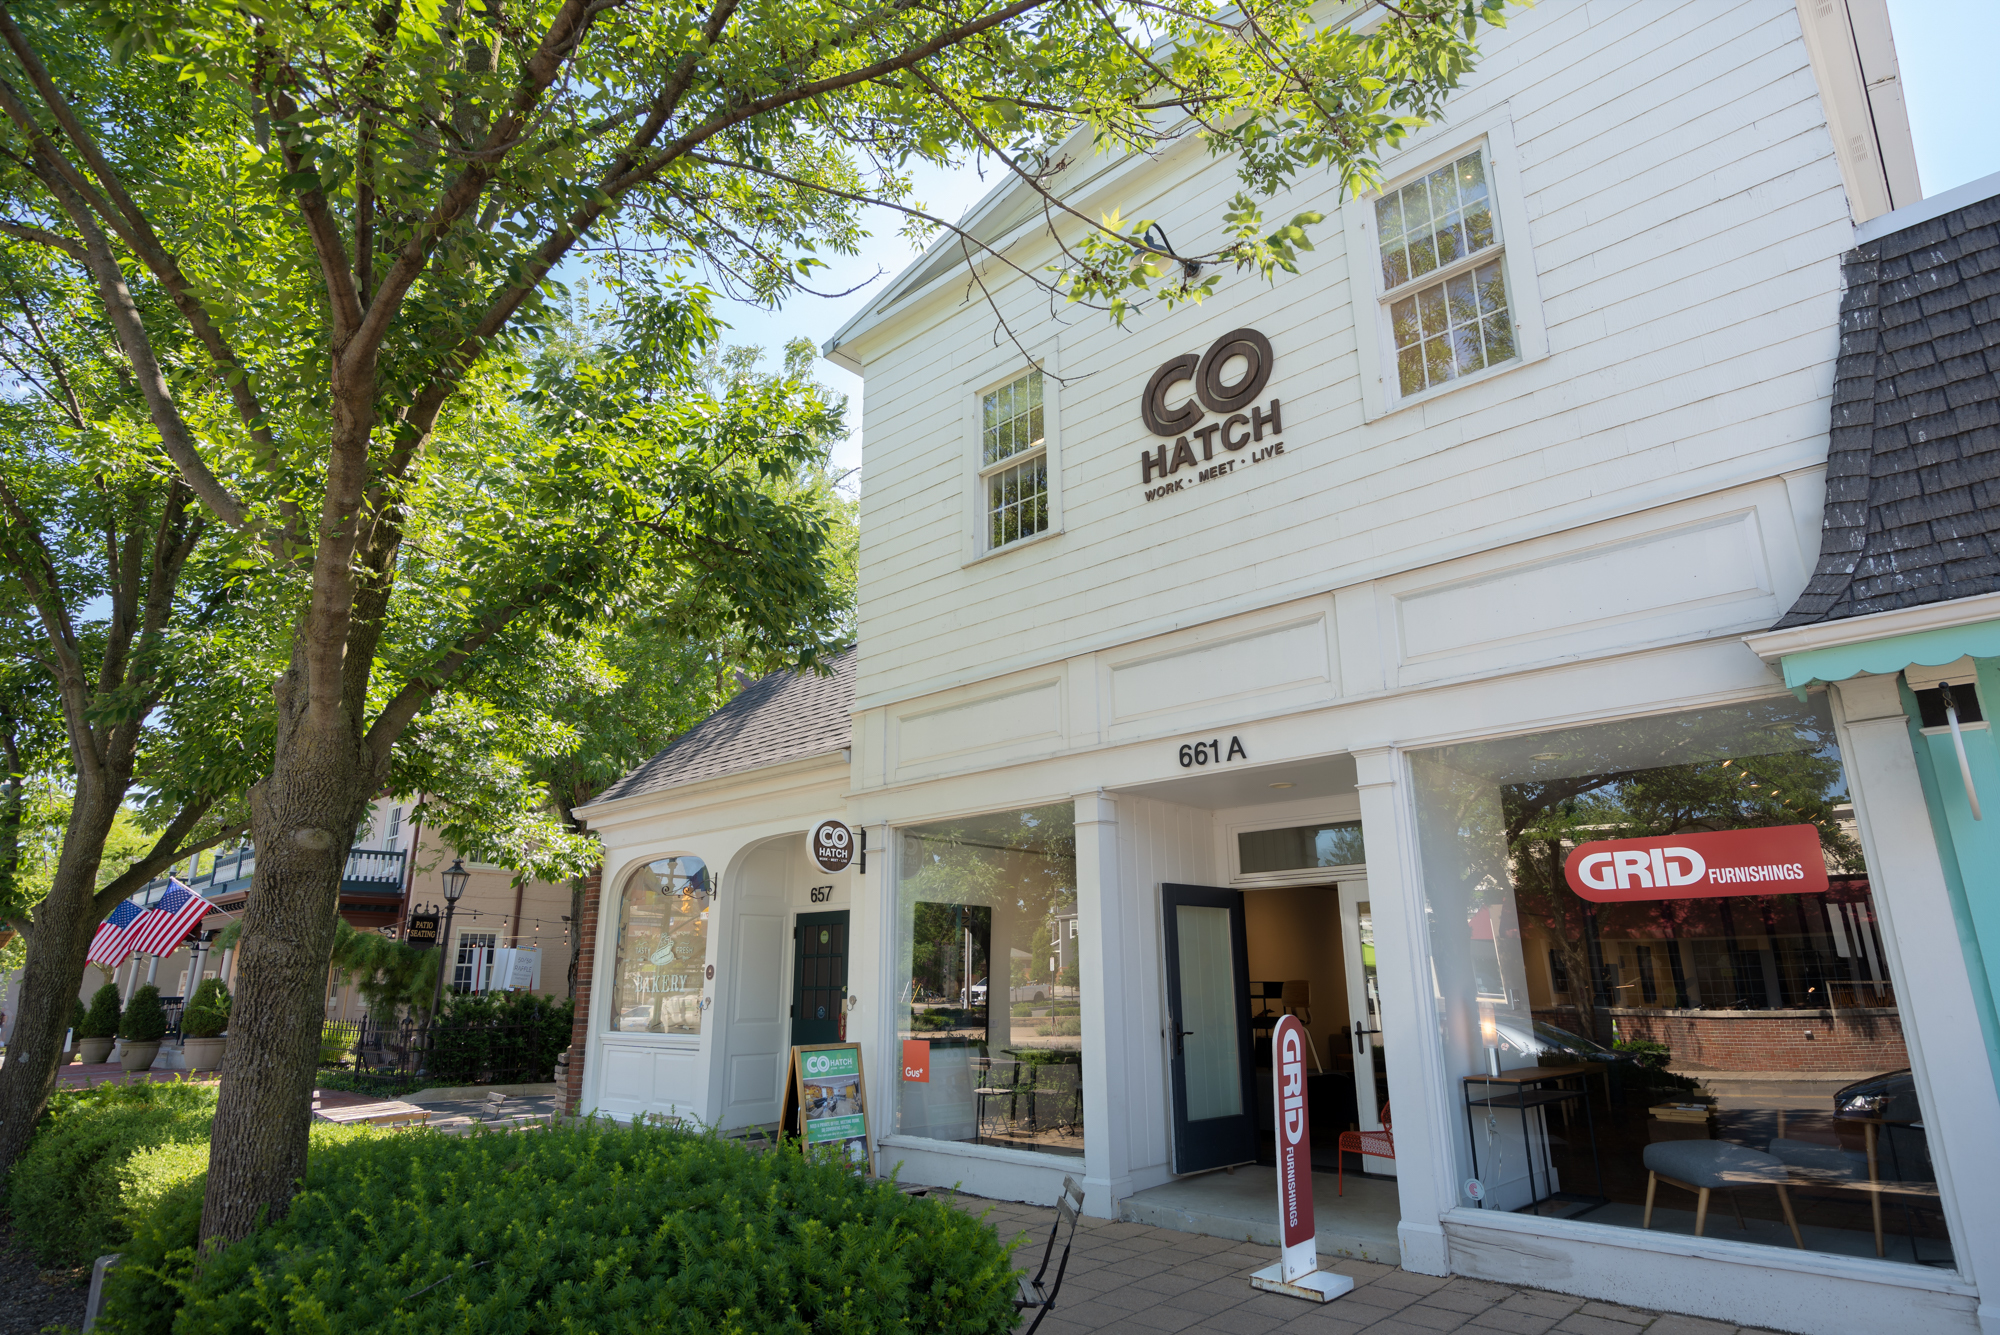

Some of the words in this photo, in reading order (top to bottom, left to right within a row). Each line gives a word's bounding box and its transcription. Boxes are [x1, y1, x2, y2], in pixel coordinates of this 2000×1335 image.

[1141, 328, 1274, 437] CO
[1141, 398, 1282, 484] HATCH
[1145, 478, 1184, 502] WORK
[1198, 459, 1236, 483] MEET
[1252, 441, 1285, 464] LIVE
[819, 826, 849, 848] CO
[819, 847, 848, 858] HATCH
[1578, 847, 1706, 890] GRID
[1708, 863, 1804, 885] FURNISHINGS
[810, 886, 833, 903] 657
[410, 929, 436, 938] SEATING
[415, 920, 434, 929] PATIO
[676, 946, 694, 954] FRESH
[514, 965, 532, 973] RAFFLE
[635, 974, 688, 993] BAKERY
[806, 1055, 830, 1073] CO
[830, 1058, 853, 1066] HATCH
[1282, 1028, 1304, 1145] GRID
[1286, 1147, 1298, 1228] FURNISHINGS
